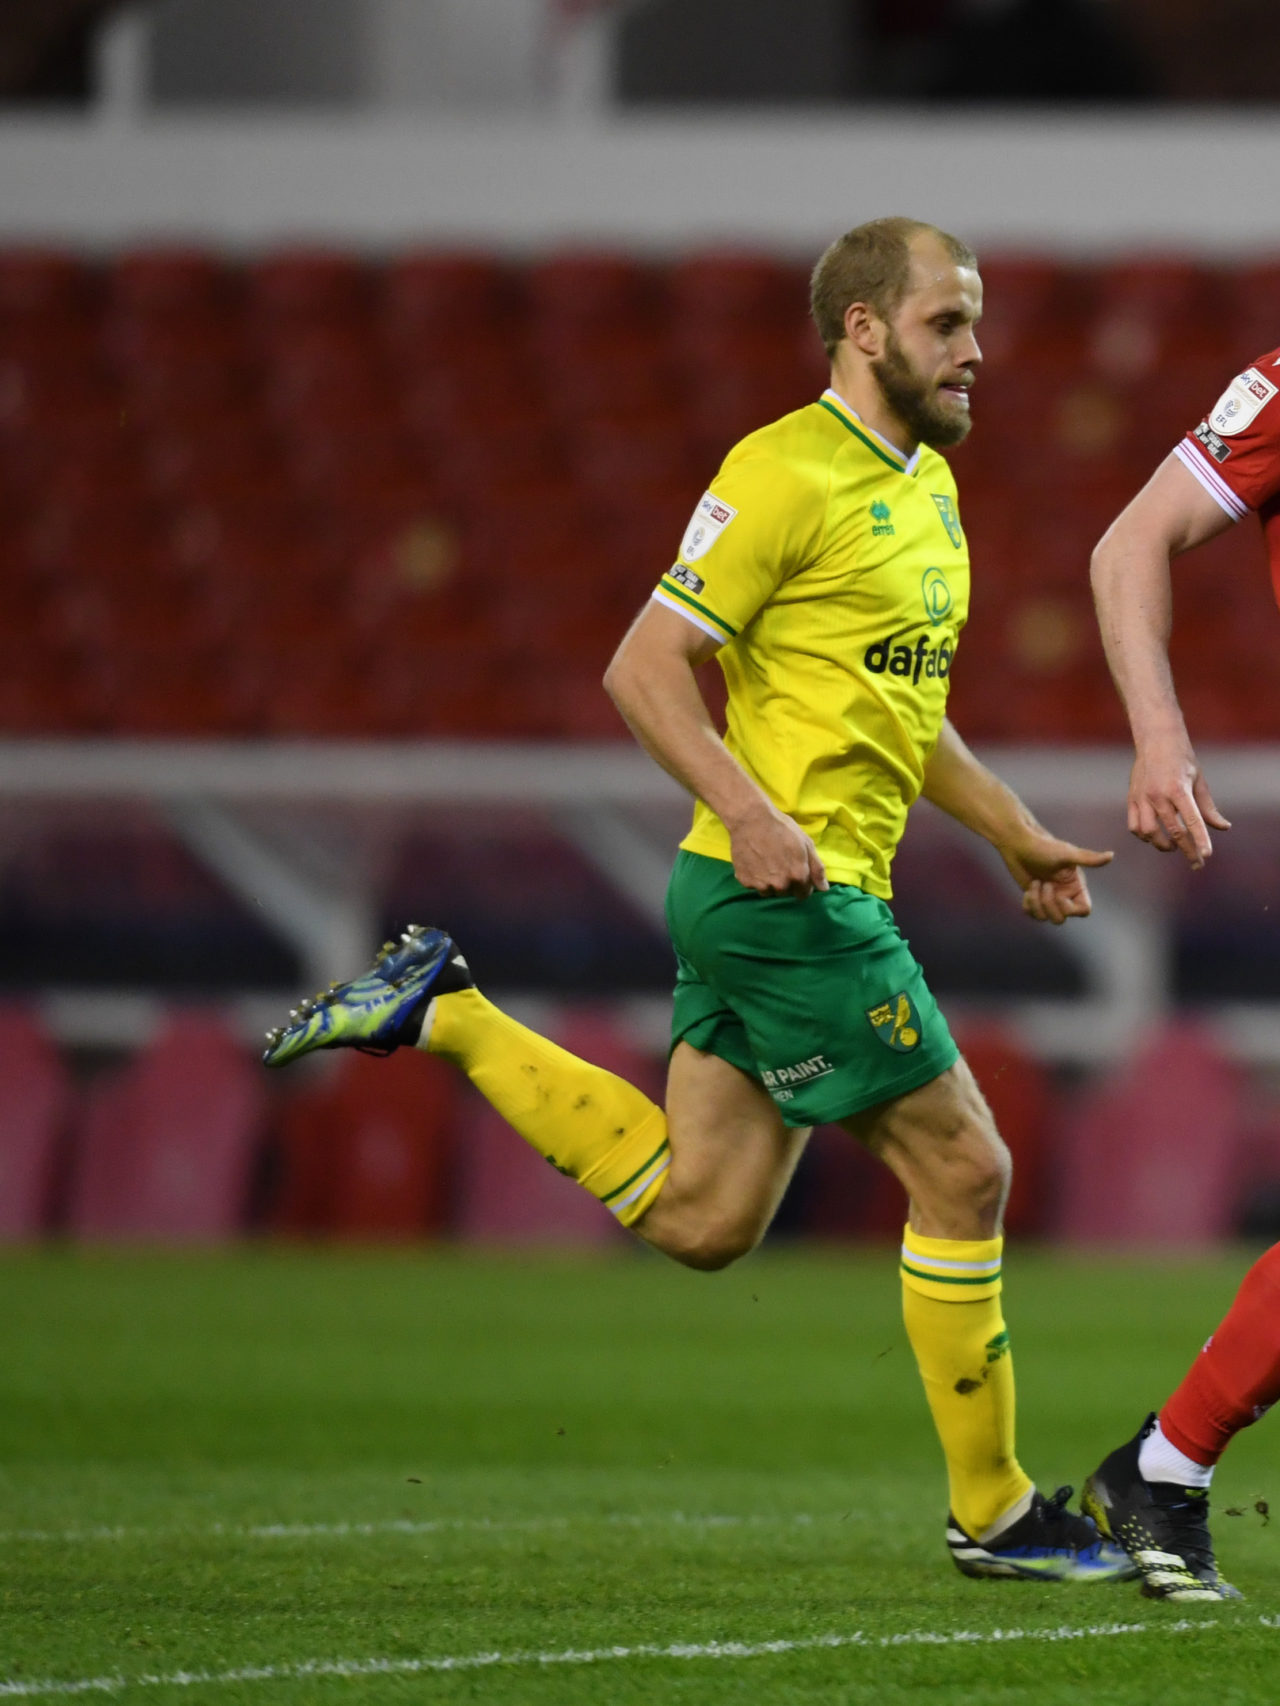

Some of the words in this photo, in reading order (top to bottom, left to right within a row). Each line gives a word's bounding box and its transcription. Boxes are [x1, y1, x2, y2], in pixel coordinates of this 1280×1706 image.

[1251, 381, 1269, 398] bet
[1215, 414, 1228, 428] EFL
[712, 506, 729, 522] bet
[864, 633, 953, 686] dafab
[776, 1055, 833, 1084] PAINT.
